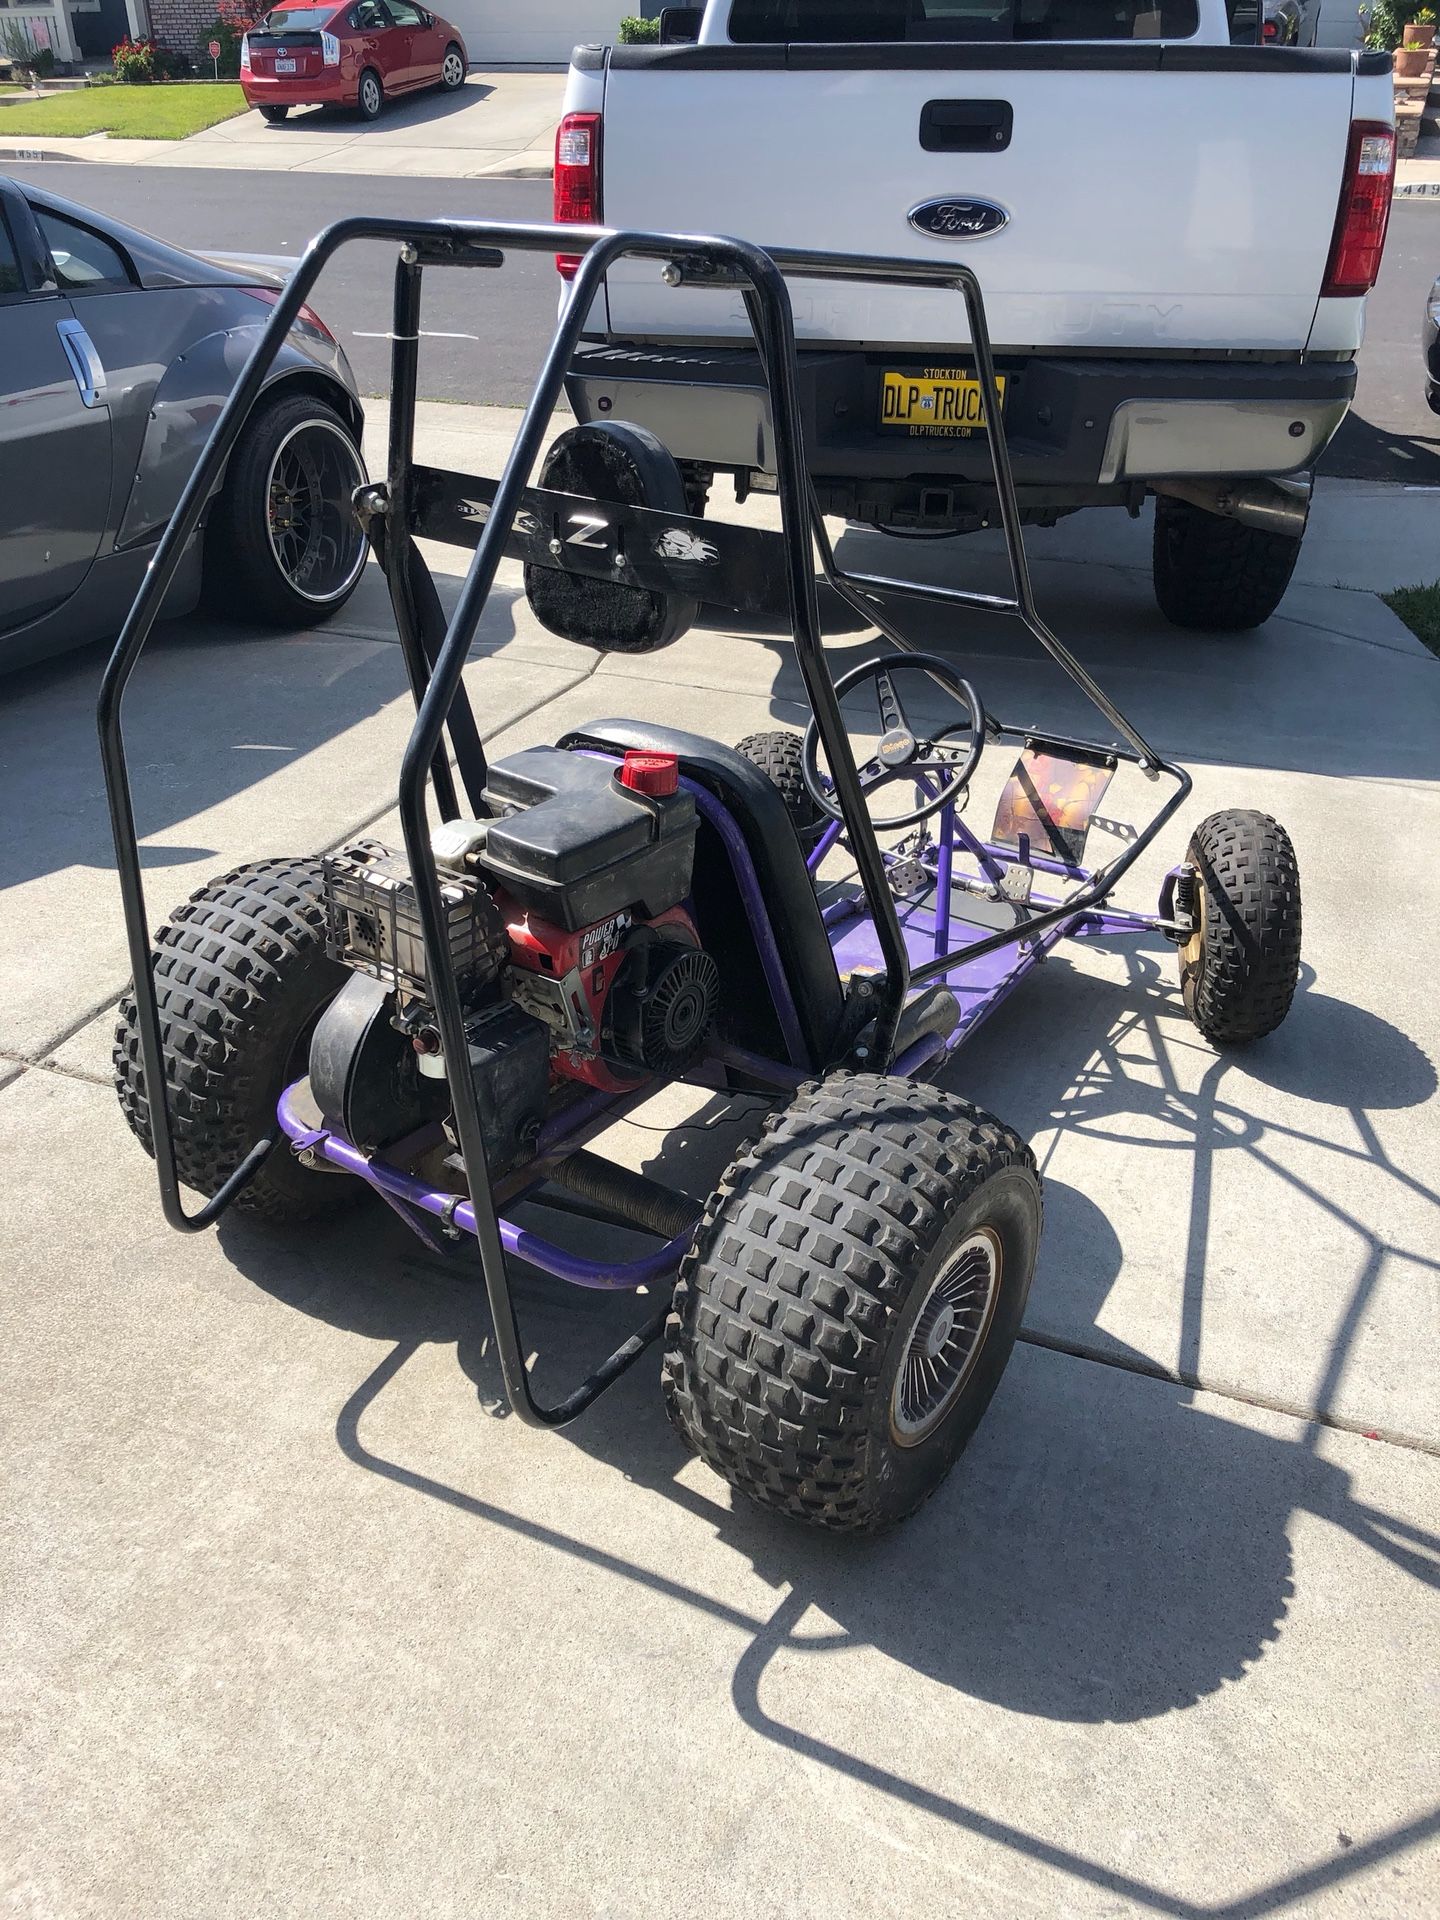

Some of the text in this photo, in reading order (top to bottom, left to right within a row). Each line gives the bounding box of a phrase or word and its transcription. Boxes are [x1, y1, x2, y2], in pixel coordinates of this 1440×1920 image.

[930, 205, 986, 231] Ford
[923, 368, 967, 380] STOCKTON
[883, 385, 1001, 423] DLP TRUC
[909, 425, 972, 438] DLPTRUCKS.COM
[582, 919, 615, 951] POWER
